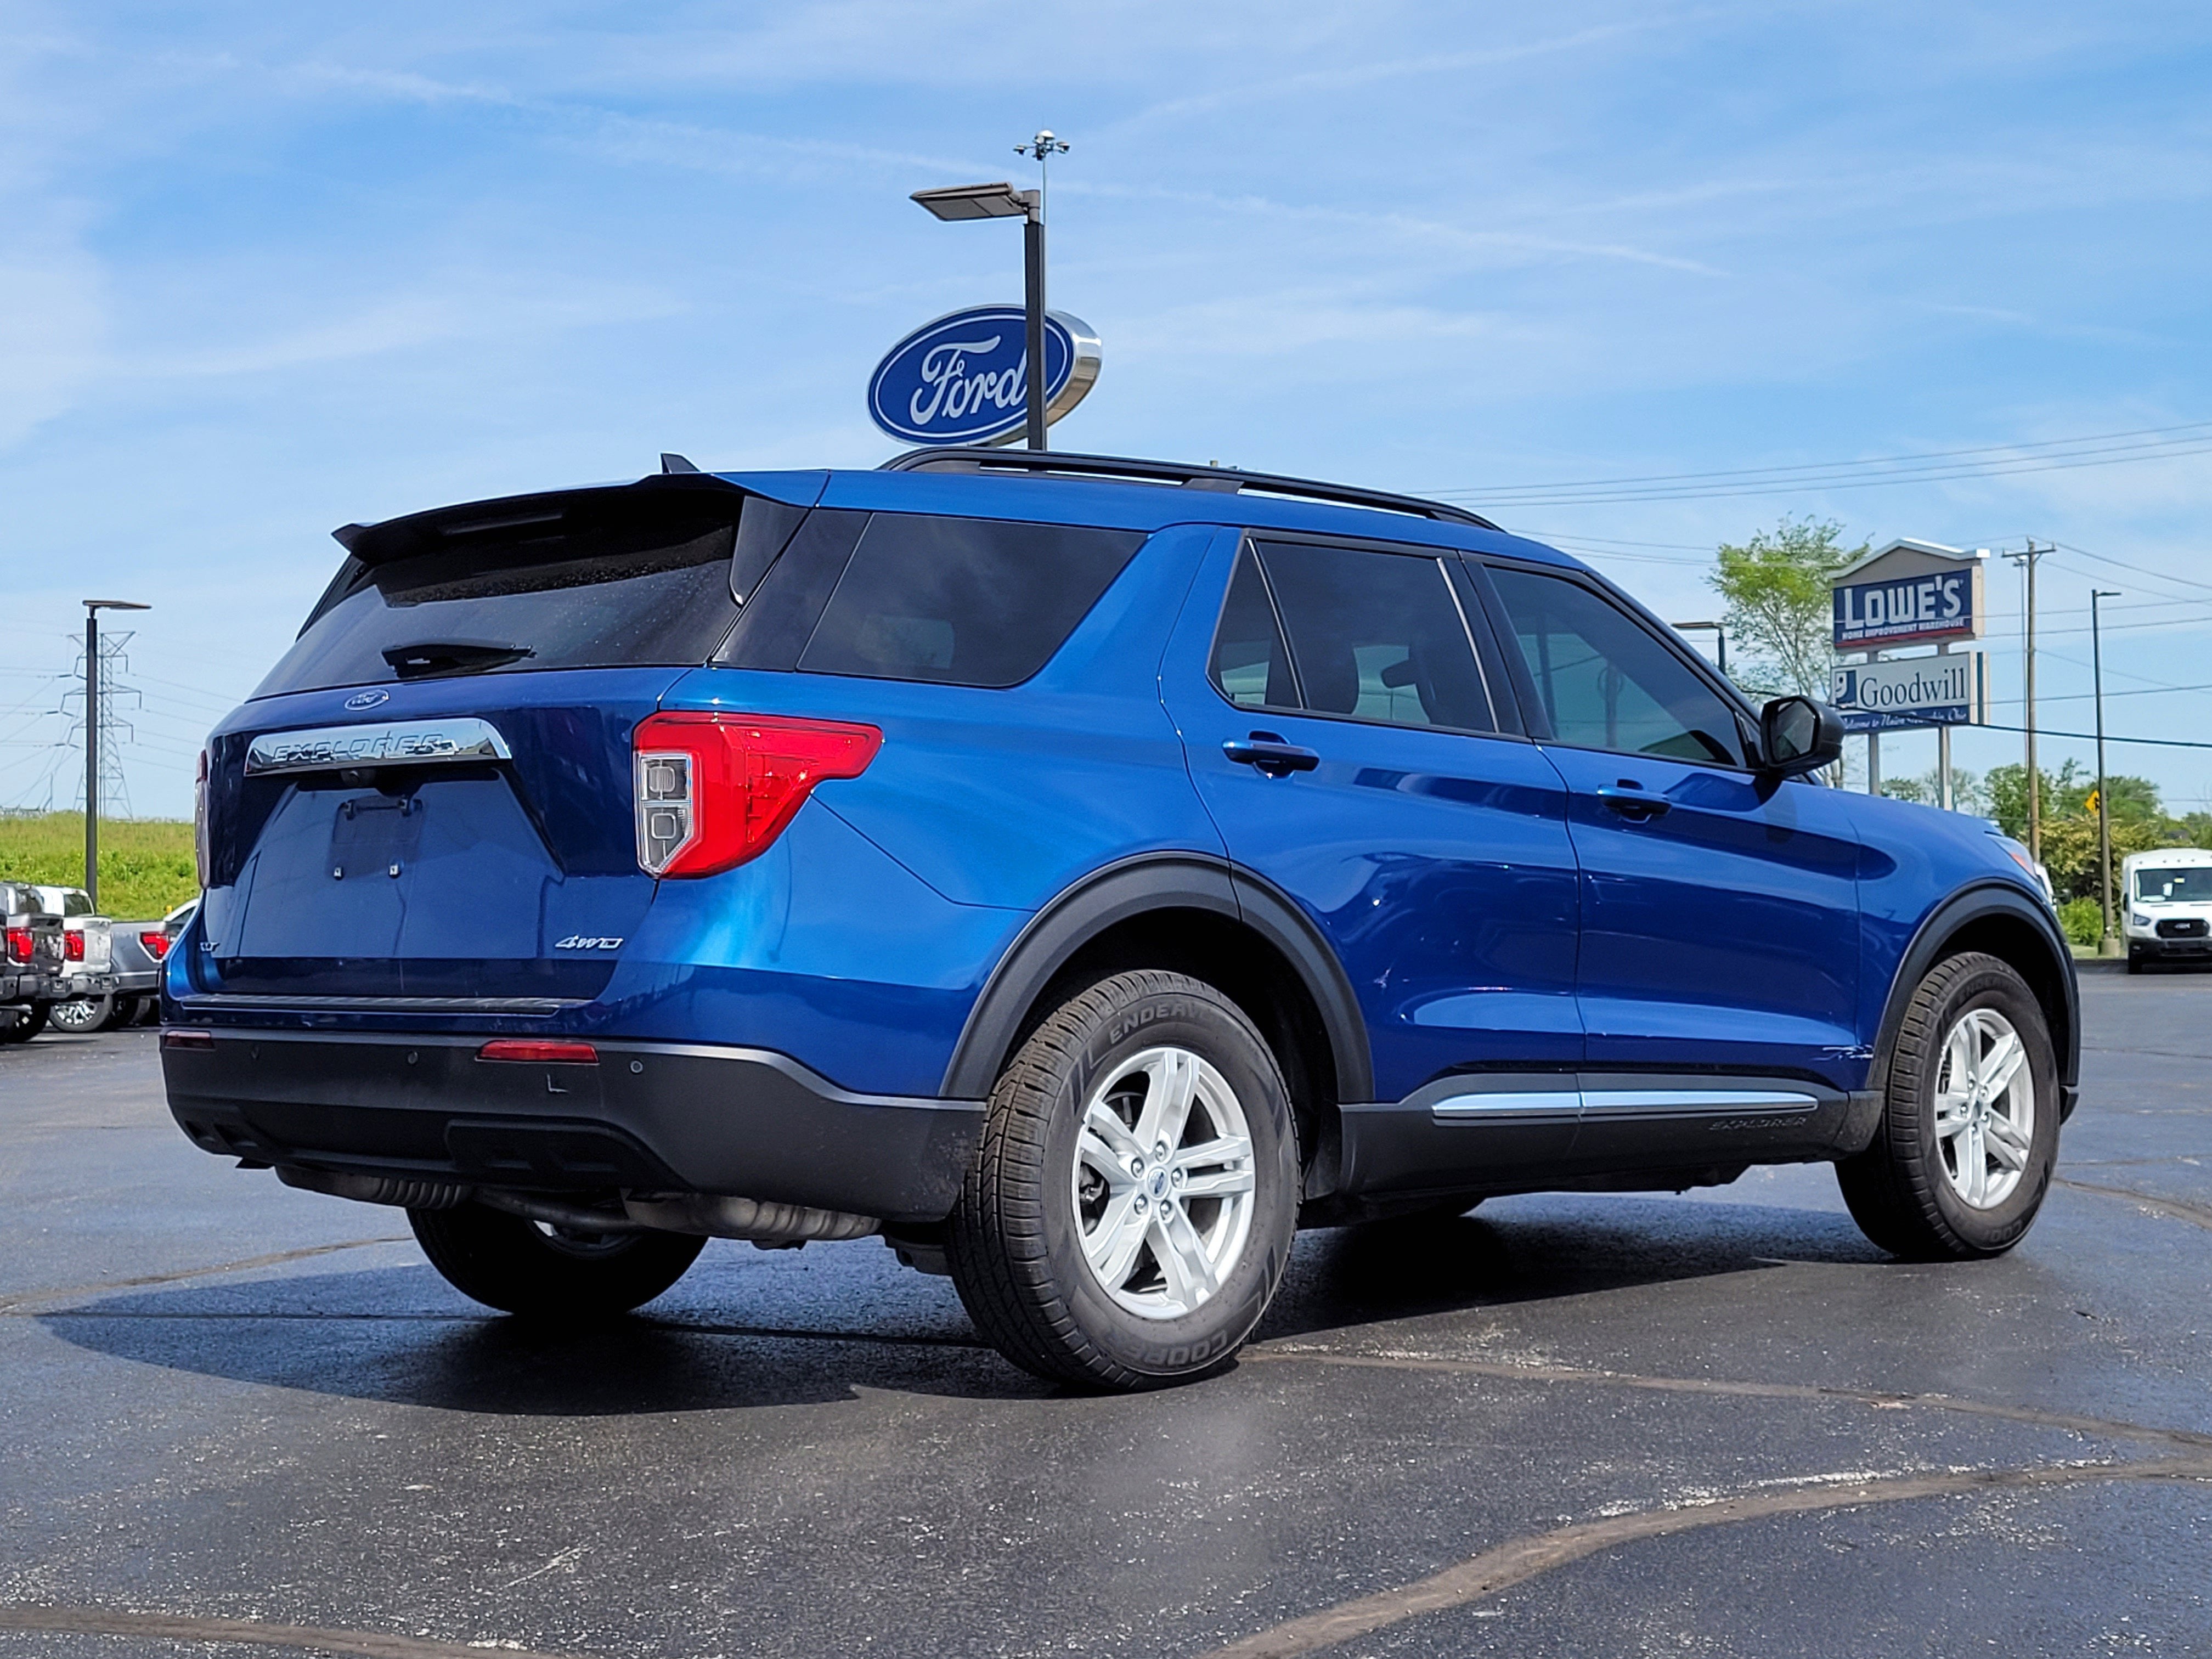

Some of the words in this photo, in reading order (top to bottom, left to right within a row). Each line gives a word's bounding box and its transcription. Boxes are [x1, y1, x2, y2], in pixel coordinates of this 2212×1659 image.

[910, 335, 1028, 425] Ford
[1844, 575, 1961, 630] LOWE'S
[1842, 630, 1863, 640] HOME
[1865, 623, 1917, 637] IMPROVEMENT
[1860, 668, 1965, 708] Goodwill
[272, 733, 443, 763] EXPLORER
[555, 935, 624, 949] 4WD
